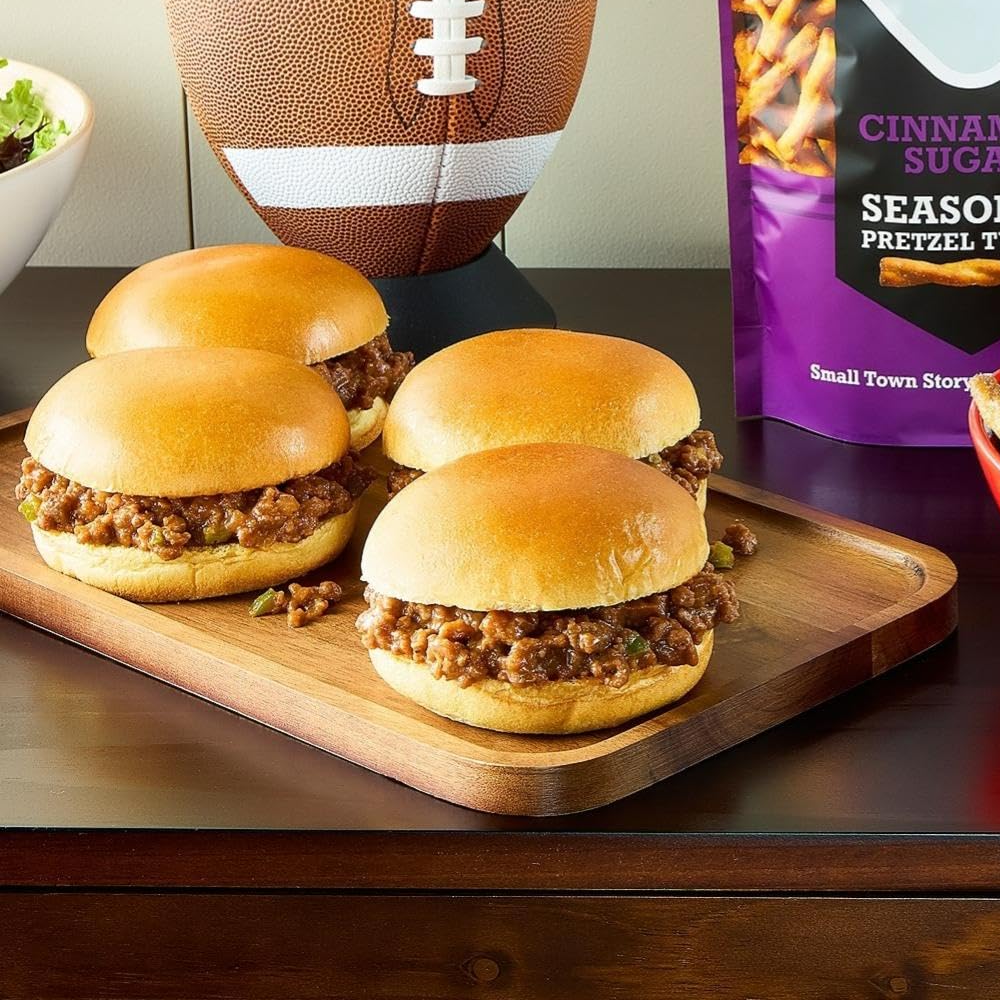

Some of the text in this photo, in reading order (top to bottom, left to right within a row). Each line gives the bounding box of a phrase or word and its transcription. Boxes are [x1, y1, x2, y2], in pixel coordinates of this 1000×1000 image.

[861, 230, 975, 251] PRETZEL
[810, 363, 972, 391] Small Town Story
